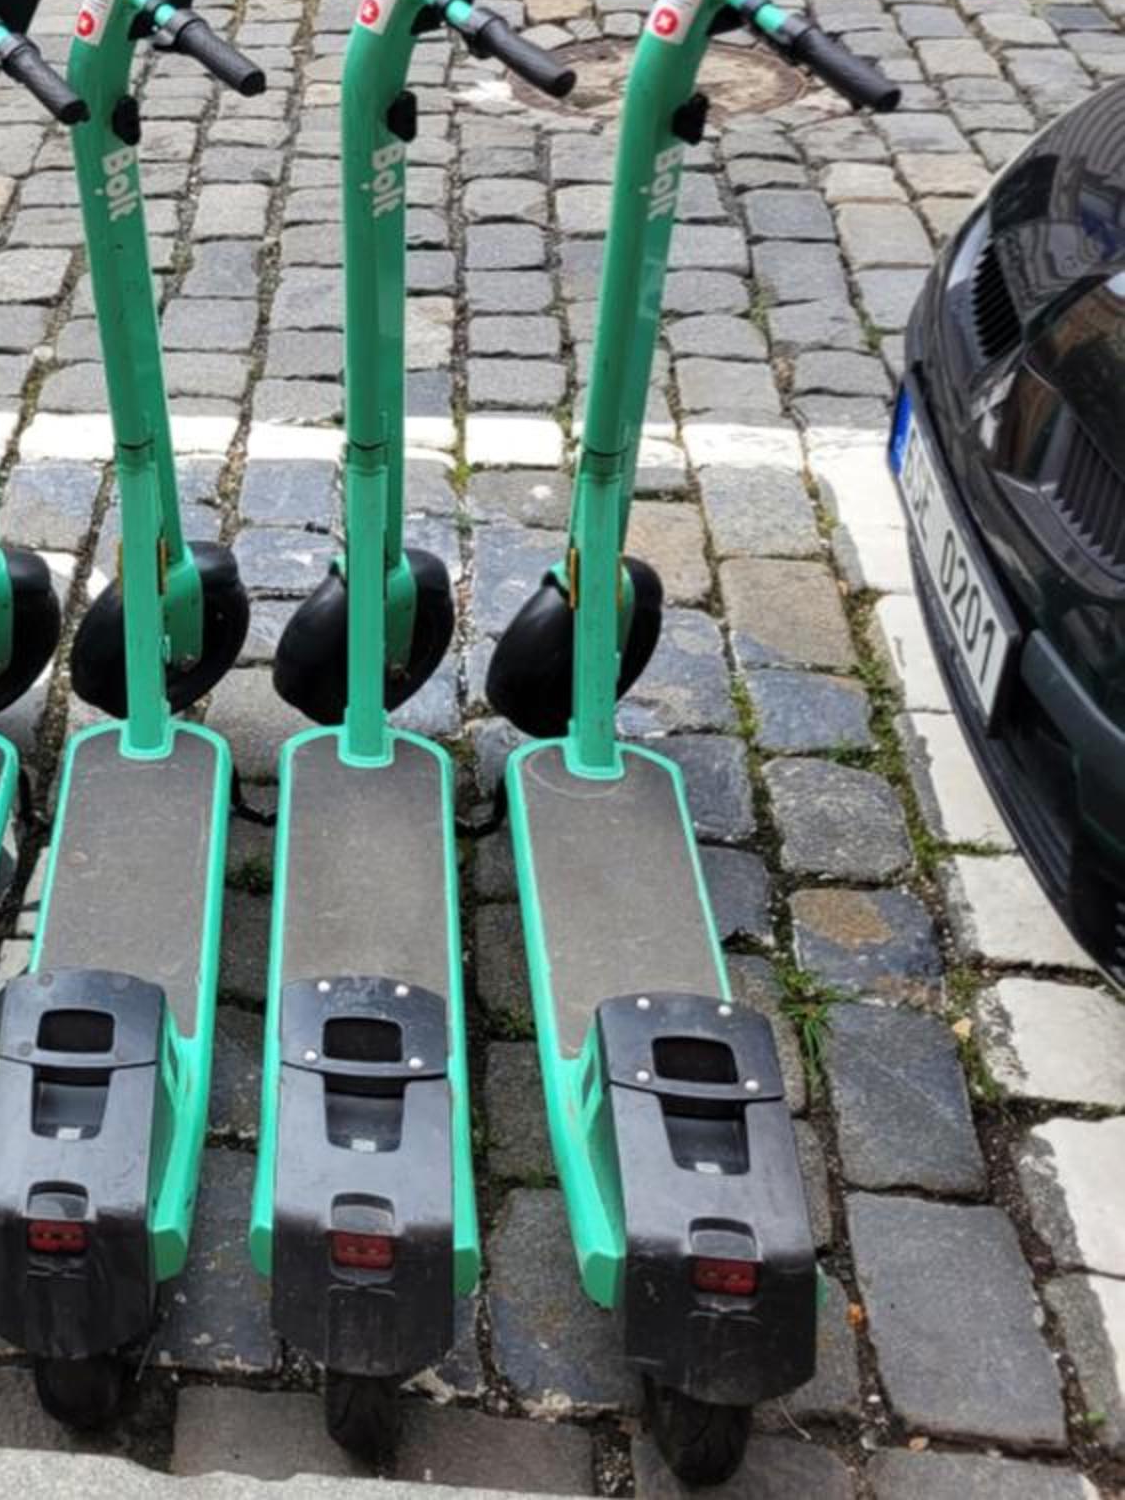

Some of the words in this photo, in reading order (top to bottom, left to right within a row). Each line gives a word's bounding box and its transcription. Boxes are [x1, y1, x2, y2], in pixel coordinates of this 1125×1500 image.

[94, 147, 139, 222] Bolt
[359, 141, 404, 219] Bolt
[639, 141, 685, 222] Bolt
[939, 529, 996, 687] 0201
